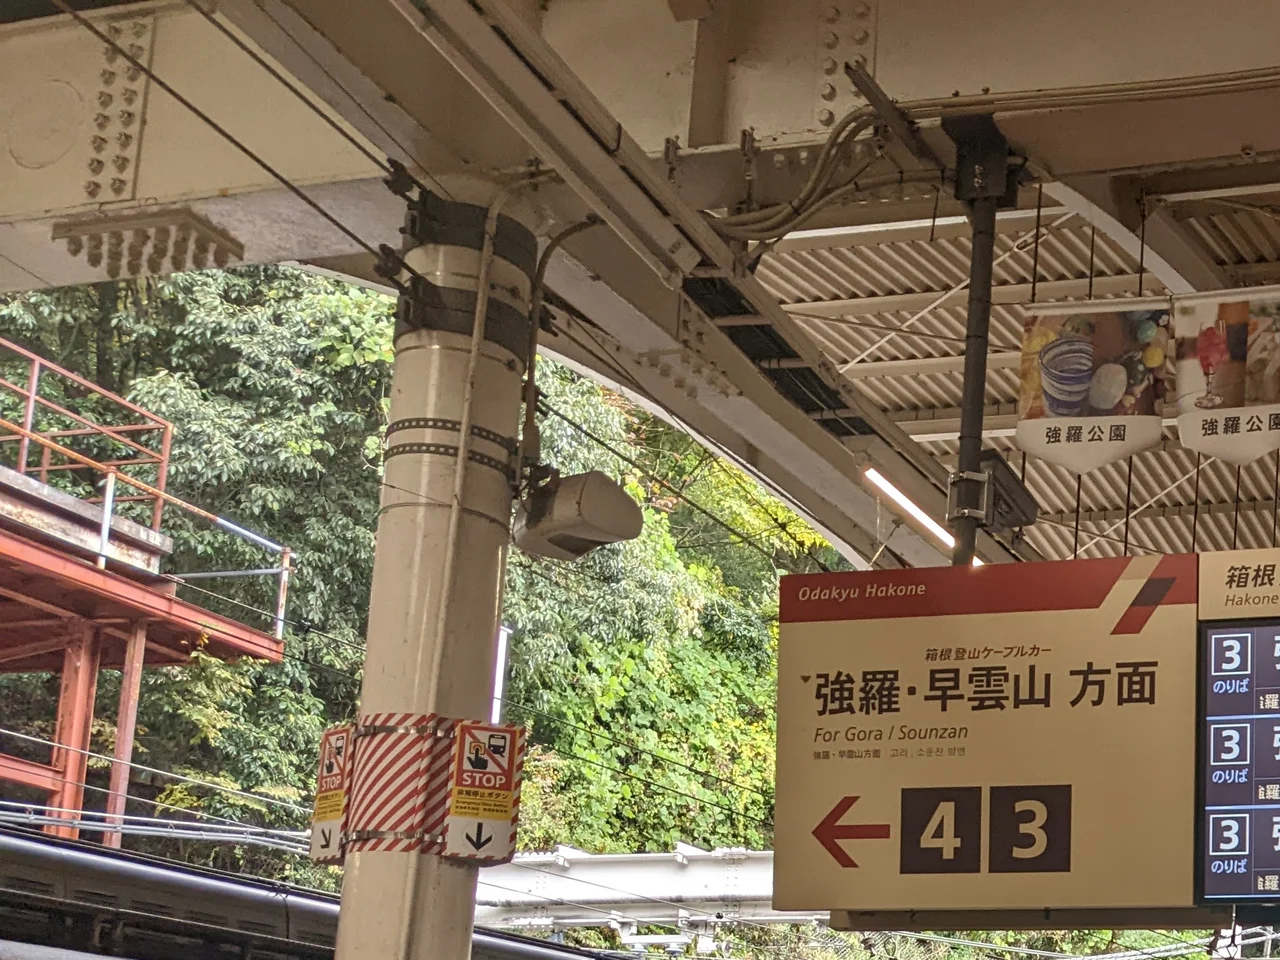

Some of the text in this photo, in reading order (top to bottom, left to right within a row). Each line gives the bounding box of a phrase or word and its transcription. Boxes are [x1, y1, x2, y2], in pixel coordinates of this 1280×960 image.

[1045, 423, 1126, 445] 強羅公園
[798, 582, 926, 602] Odakyu Hakone
[1224, 592, 1279, 607] Hakone
[924, 645, 1052, 661] 箱根登山ケーブルカー
[1220, 640, 1241, 669] 3
[814, 661, 1158, 717] 強羅・早雲山 方面
[1213, 677, 1249, 694] のりば
[814, 727, 840, 743] For
[845, 726, 883, 742] Gora
[898, 725, 968, 740] Sounzan
[1220, 730, 1241, 759] 3
[321, 775, 342, 791] STOP
[462, 772, 506, 788] STOP
[1212, 768, 1248, 784] のりば
[919, 800, 1048, 859] 4 3
[1219, 819, 1240, 849] 3
[1211, 858, 1247, 874] のりば
